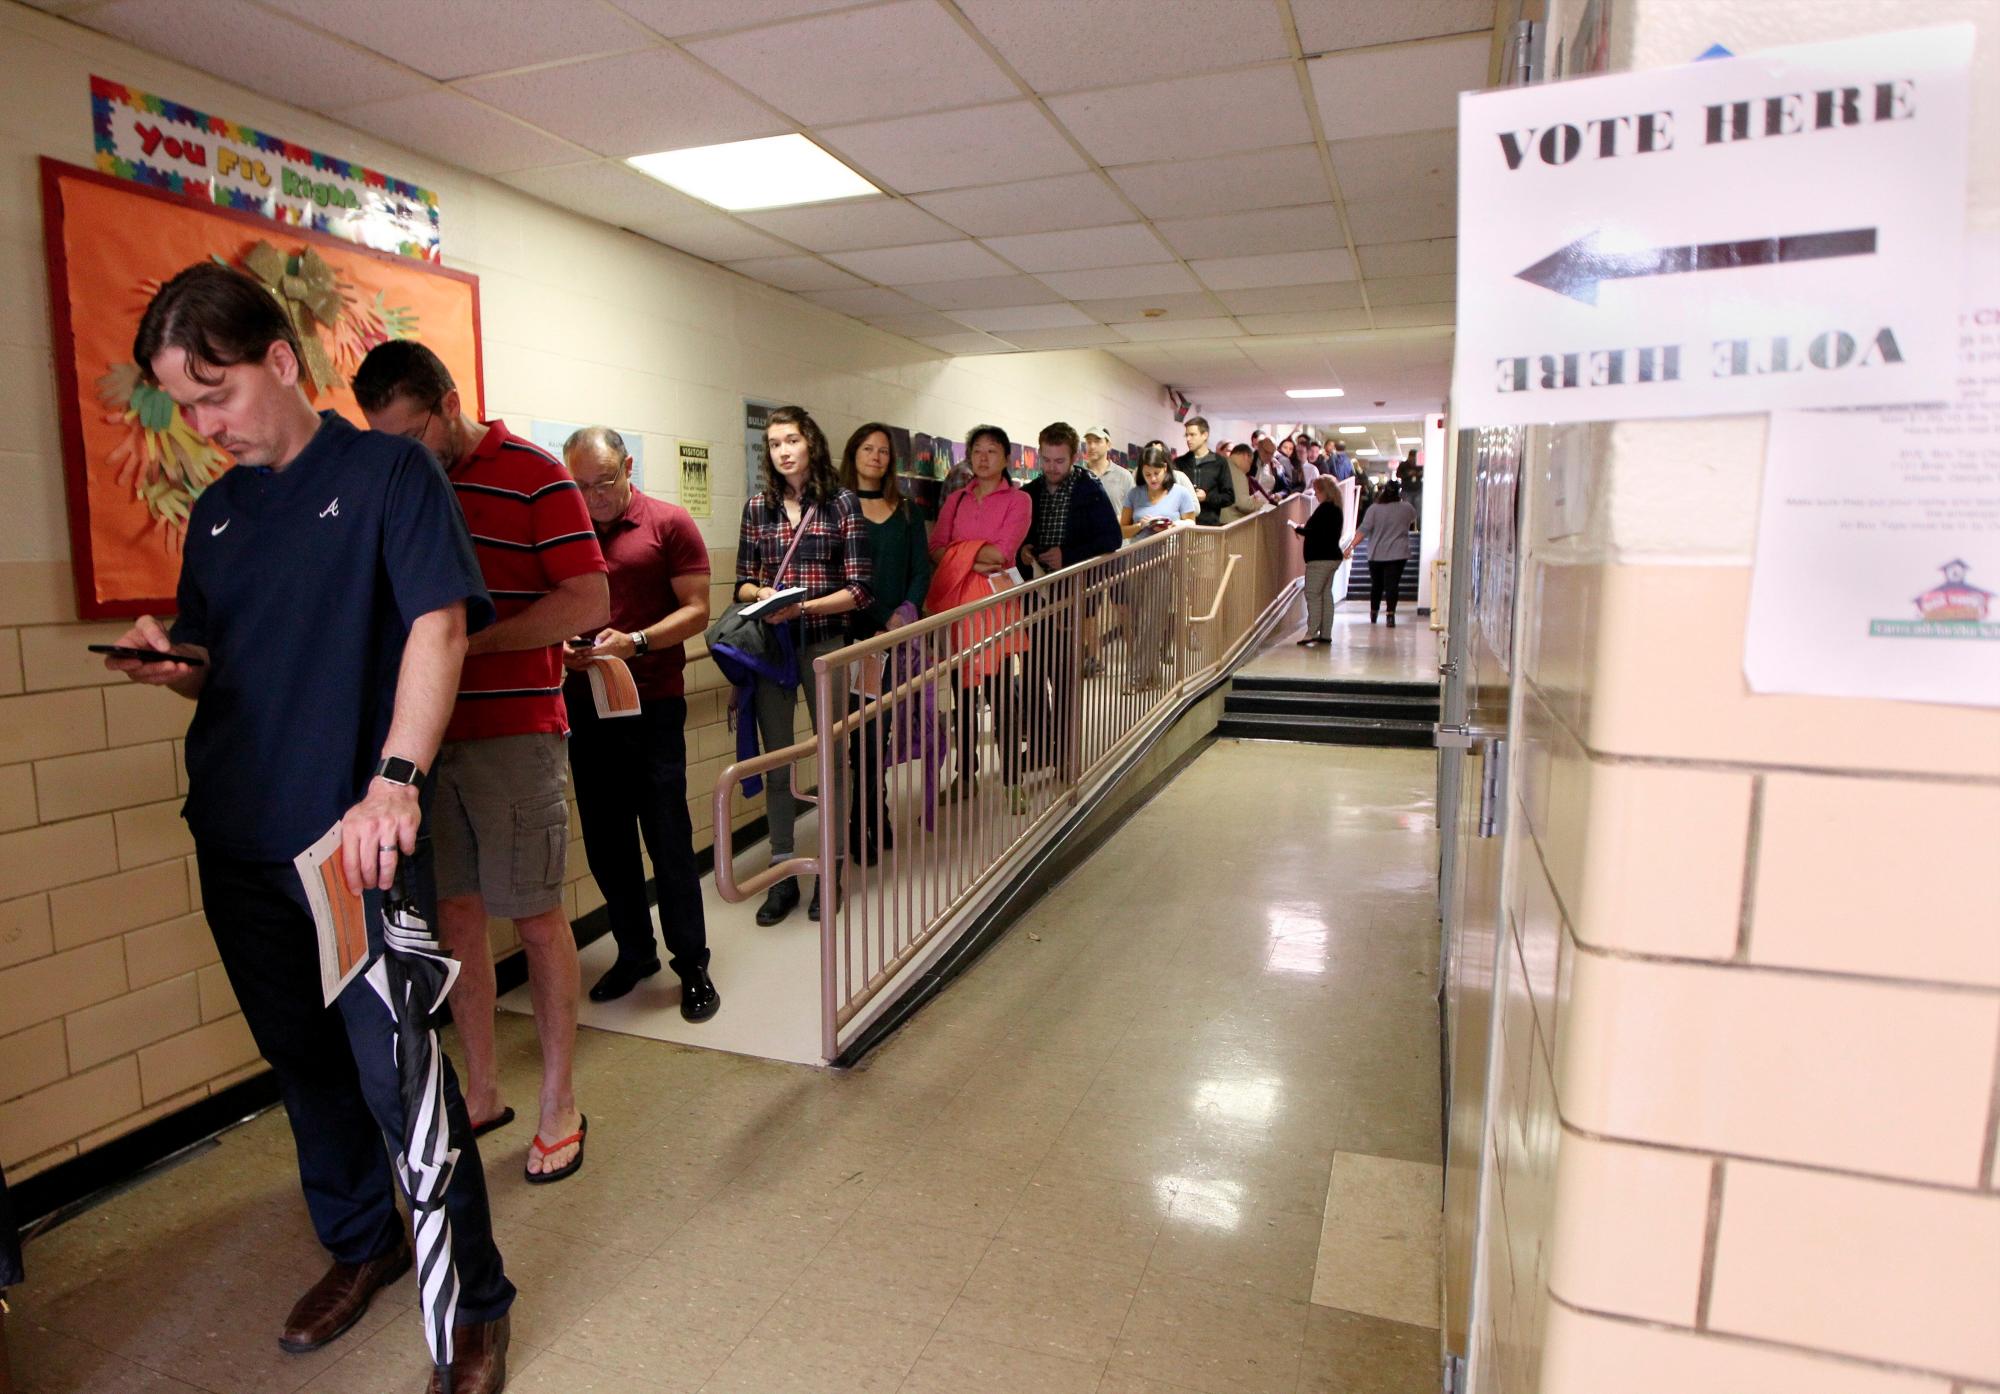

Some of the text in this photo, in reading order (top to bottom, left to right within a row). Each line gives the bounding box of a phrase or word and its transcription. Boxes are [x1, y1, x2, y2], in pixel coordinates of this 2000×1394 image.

[134, 121, 206, 167] You
[217, 146, 271, 188] Fit
[1497, 80, 1916, 171] VOTE HERE
[1496, 326, 1905, 393] VOTE HERE
[682, 447, 706, 457] VISITORS
